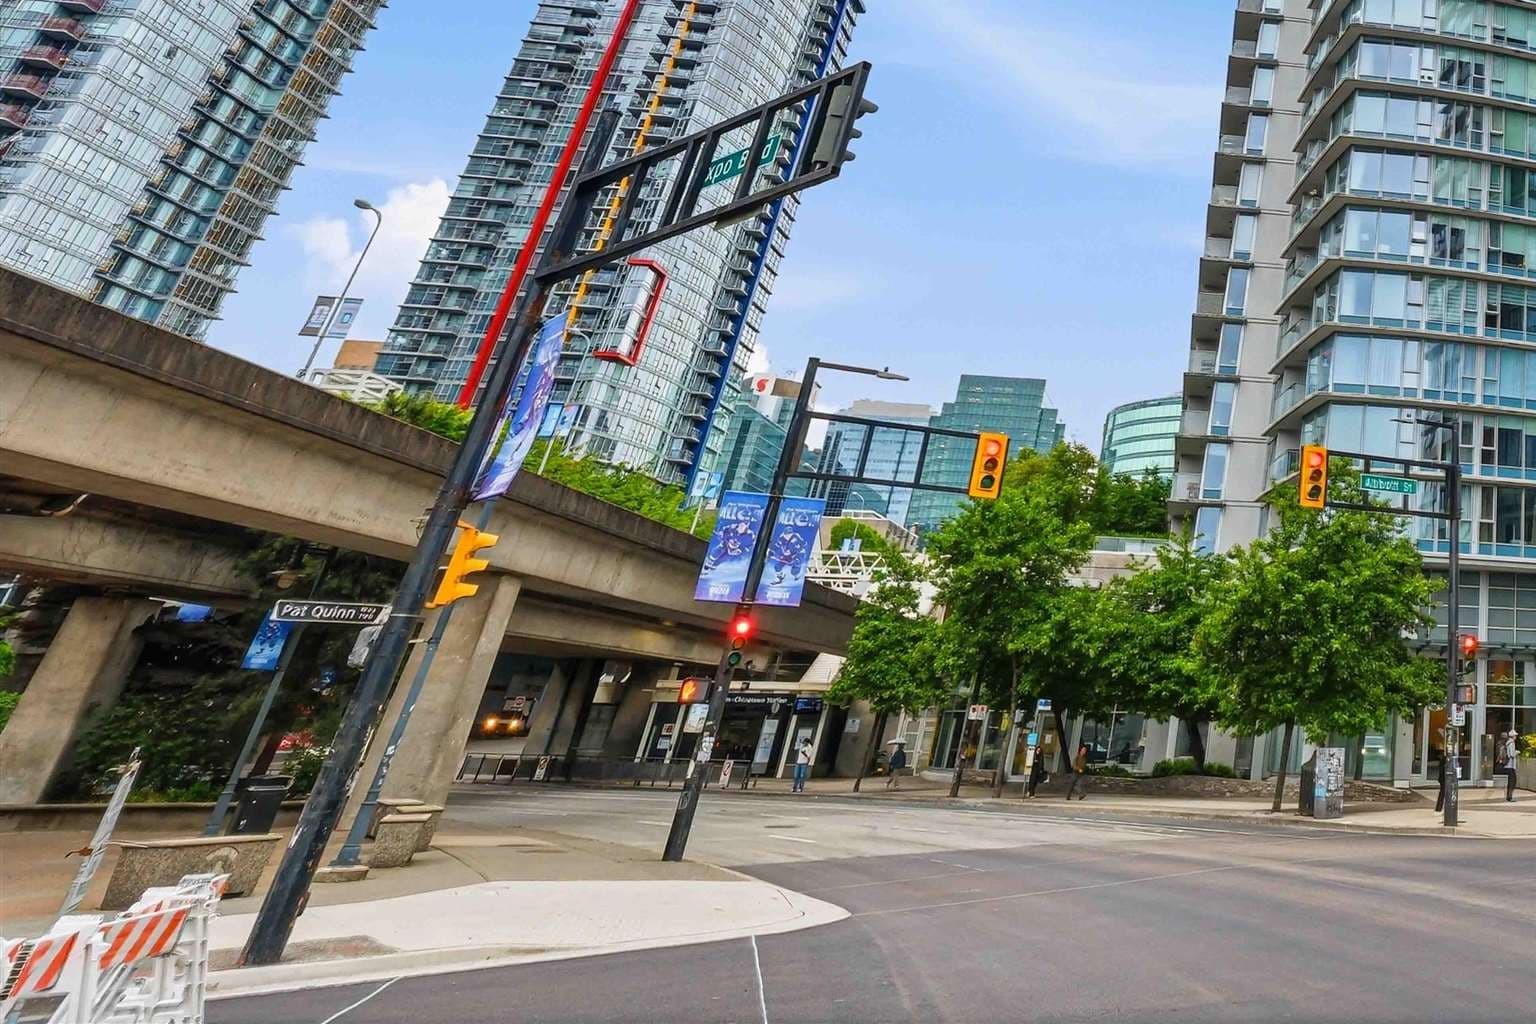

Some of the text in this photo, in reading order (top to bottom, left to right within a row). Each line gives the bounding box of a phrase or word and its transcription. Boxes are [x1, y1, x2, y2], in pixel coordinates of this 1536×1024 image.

[705, 159, 733, 183] xpo
[280, 603, 310, 617] Pat
[311, 605, 356, 620] Quinn
